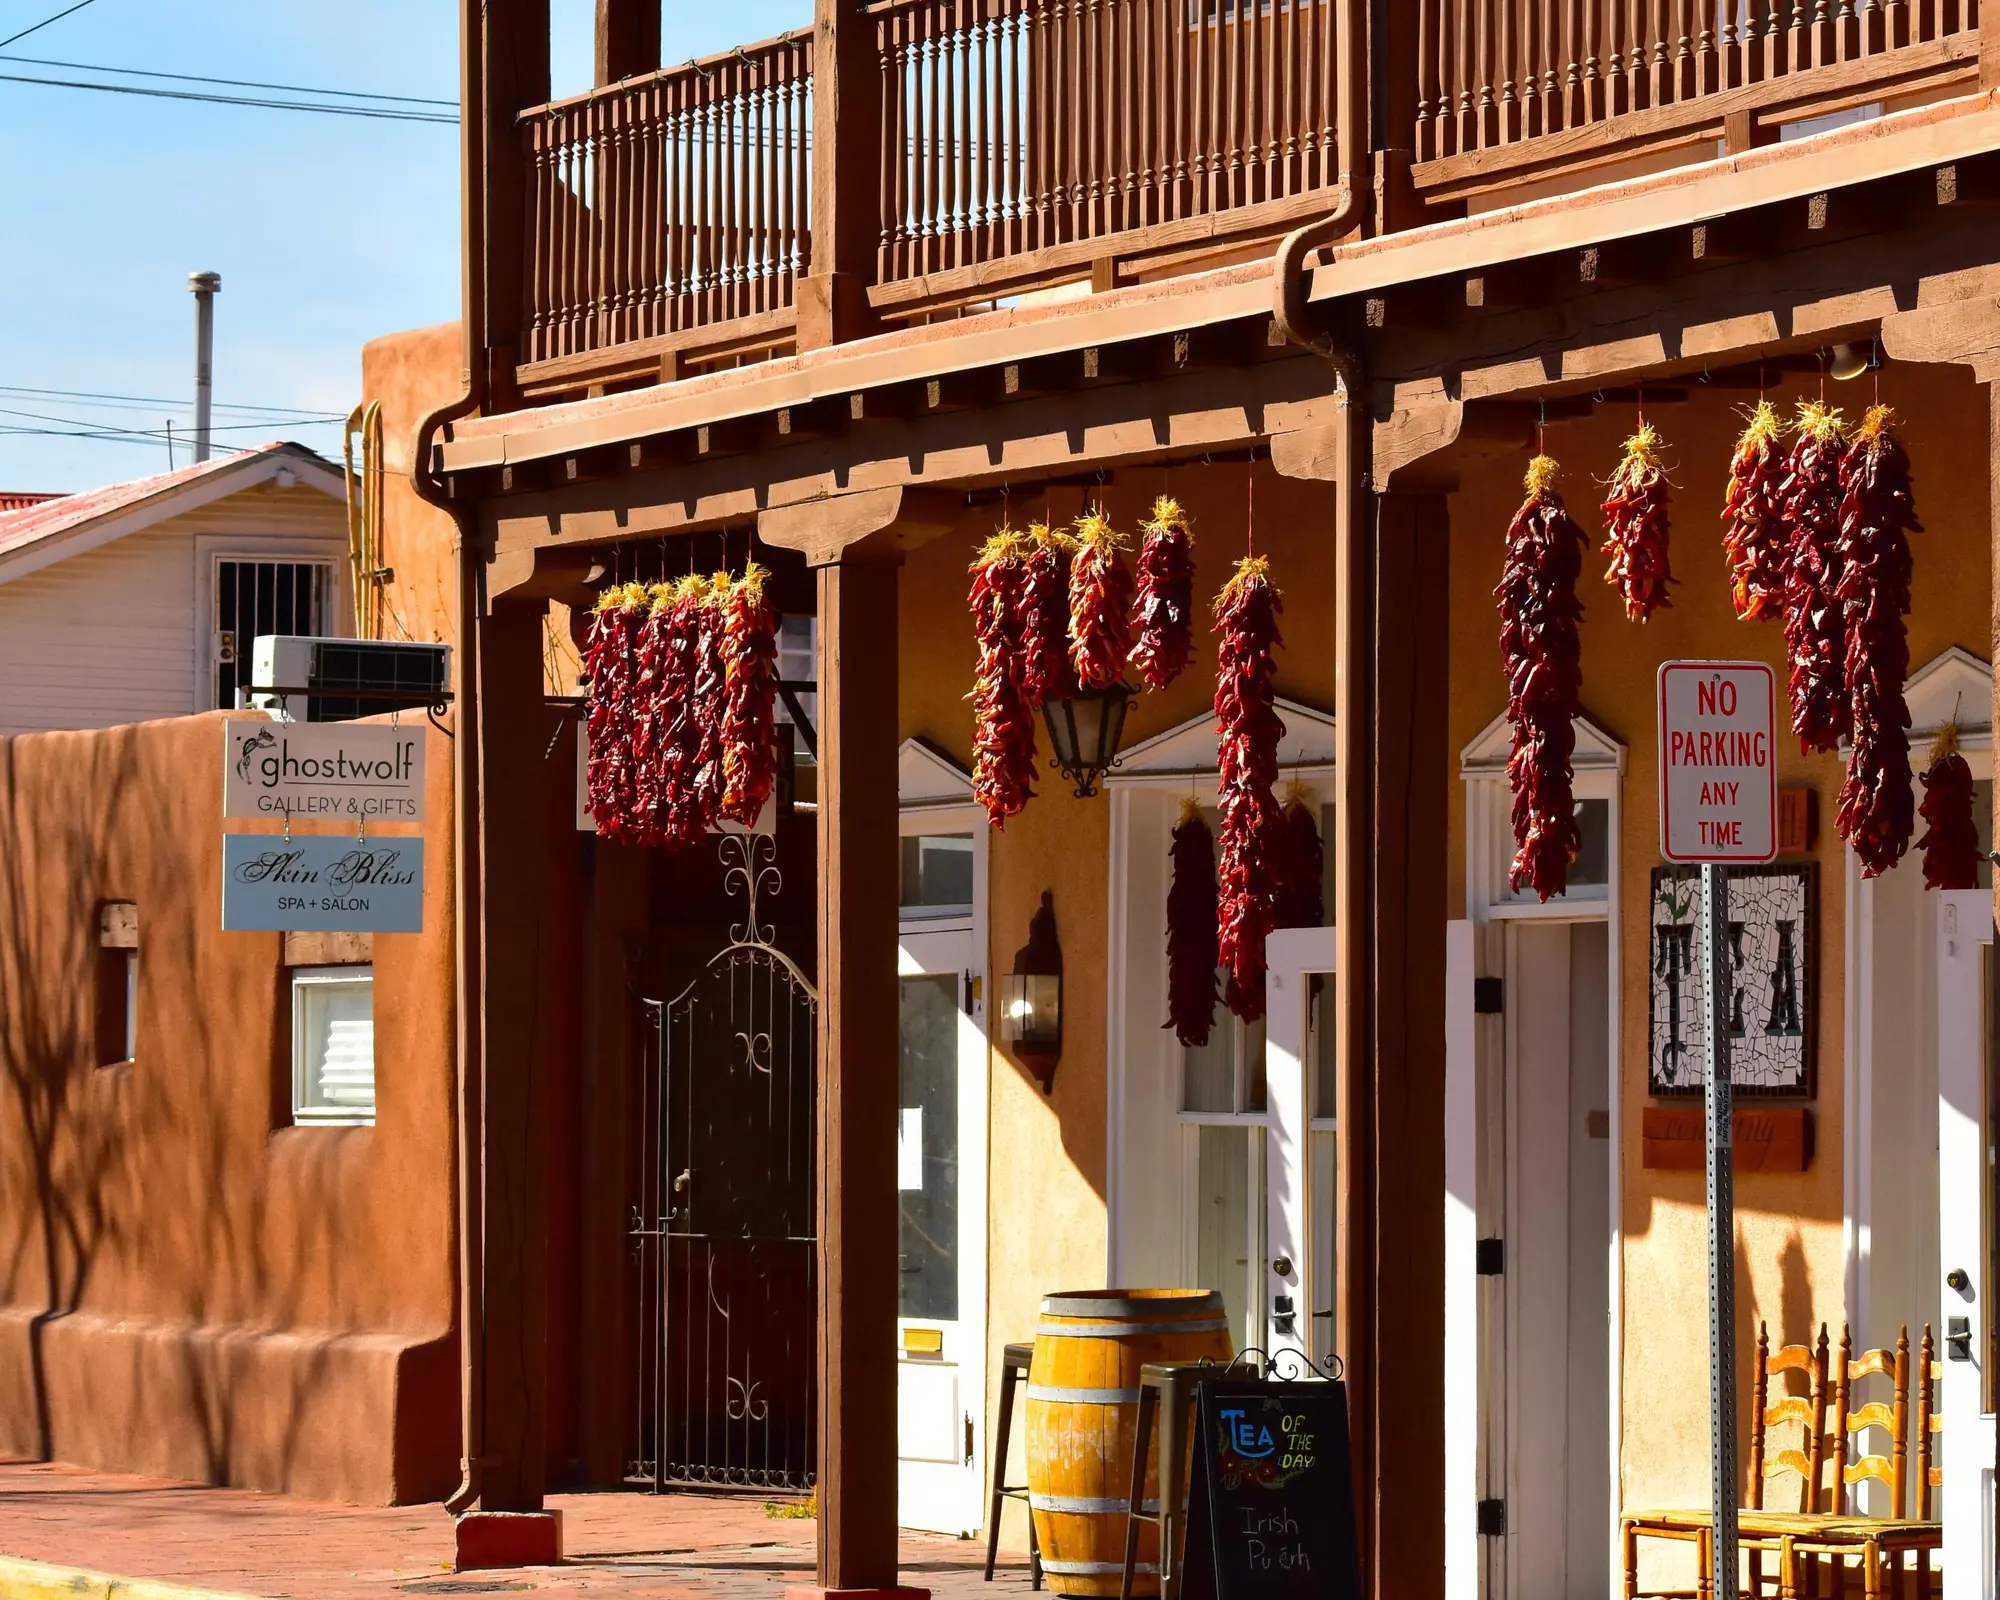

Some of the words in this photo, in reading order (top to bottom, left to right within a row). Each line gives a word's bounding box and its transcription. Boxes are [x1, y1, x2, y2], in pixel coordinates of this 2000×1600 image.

[1698, 680, 1737, 717] NO
[1671, 731, 1766, 768] PARKING
[261, 738, 415, 788] ghostwolf
[257, 795, 343, 814] GALLERY
[347, 797, 359, 814] &
[363, 798, 416, 816] GIFTS
[1699, 781, 1740, 806] ANY
[1698, 821, 1743, 846] TIME
[234, 849, 319, 884] Skin
[324, 849, 415, 898] Bliss
[278, 897, 306, 910] SPA
[321, 898, 370, 911] SALON
[1221, 1409, 1276, 1458] TEA
[1281, 1415, 1306, 1433] OF
[1287, 1434, 1314, 1451] THE
[1282, 1454, 1314, 1469] DAY
[1238, 1506, 1300, 1536] Irish
